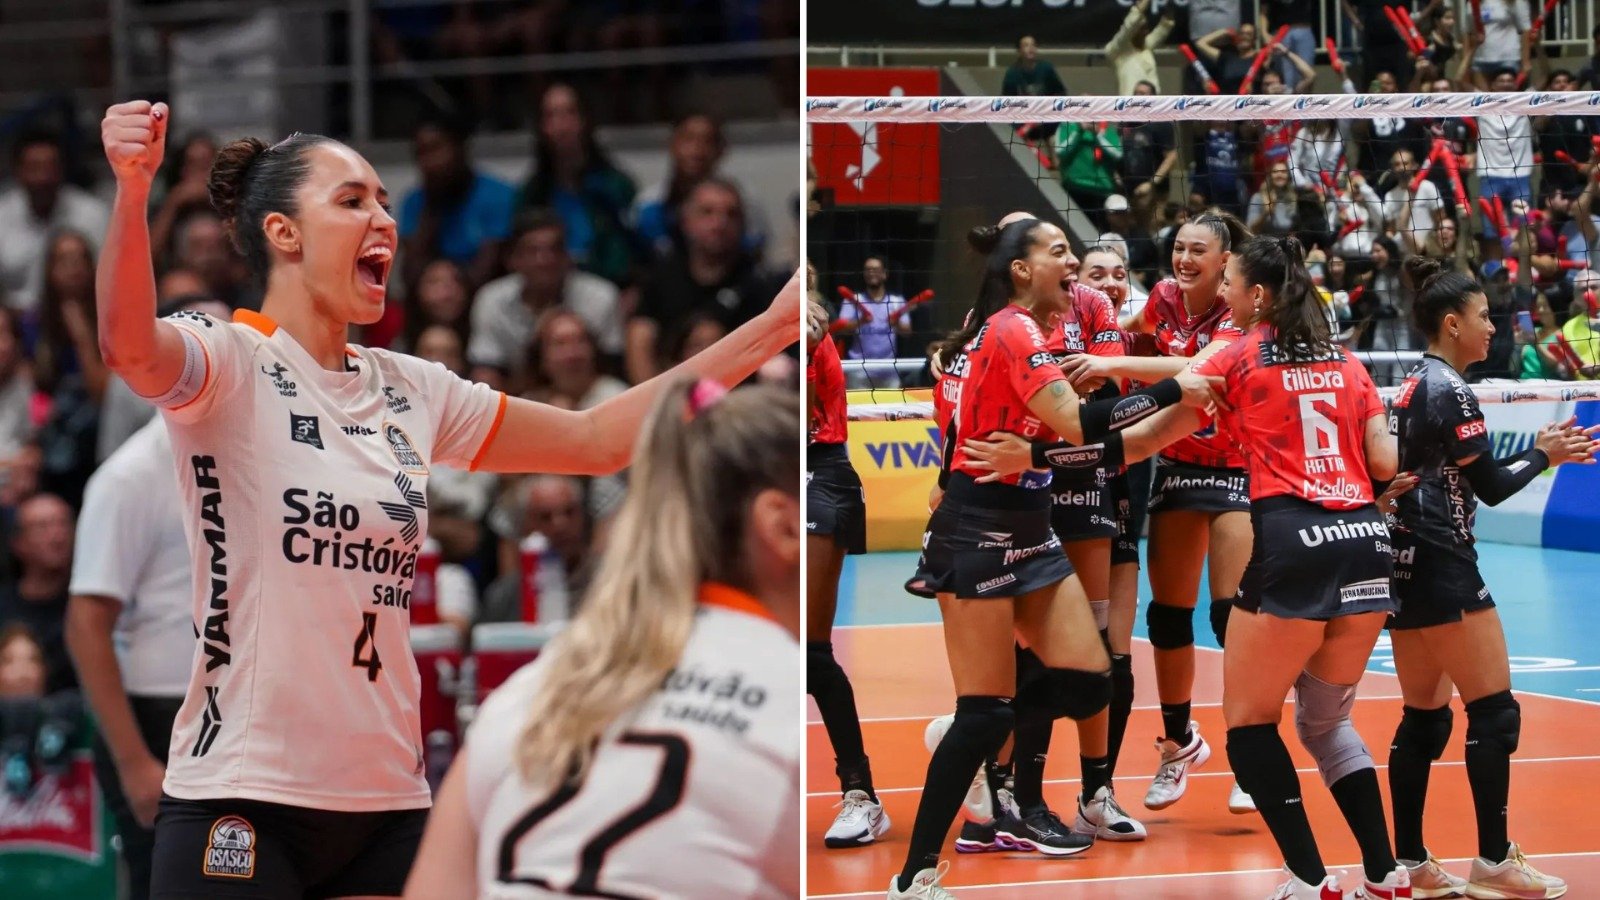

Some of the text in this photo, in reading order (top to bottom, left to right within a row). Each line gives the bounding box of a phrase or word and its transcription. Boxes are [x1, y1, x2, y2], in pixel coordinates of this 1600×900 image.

[1282, 366, 1345, 392] tilibra
[1298, 391, 1341, 458] 6
[282, 488, 361, 531] São
[1050, 491, 1100, 507] ndelli
[191, 455, 231, 674] YANMAR
[282, 527, 420, 580] Cristóvã
[1393, 570, 1411, 580] uru
[352, 611, 382, 682] 4
[207, 848, 252, 868] OSASCO
